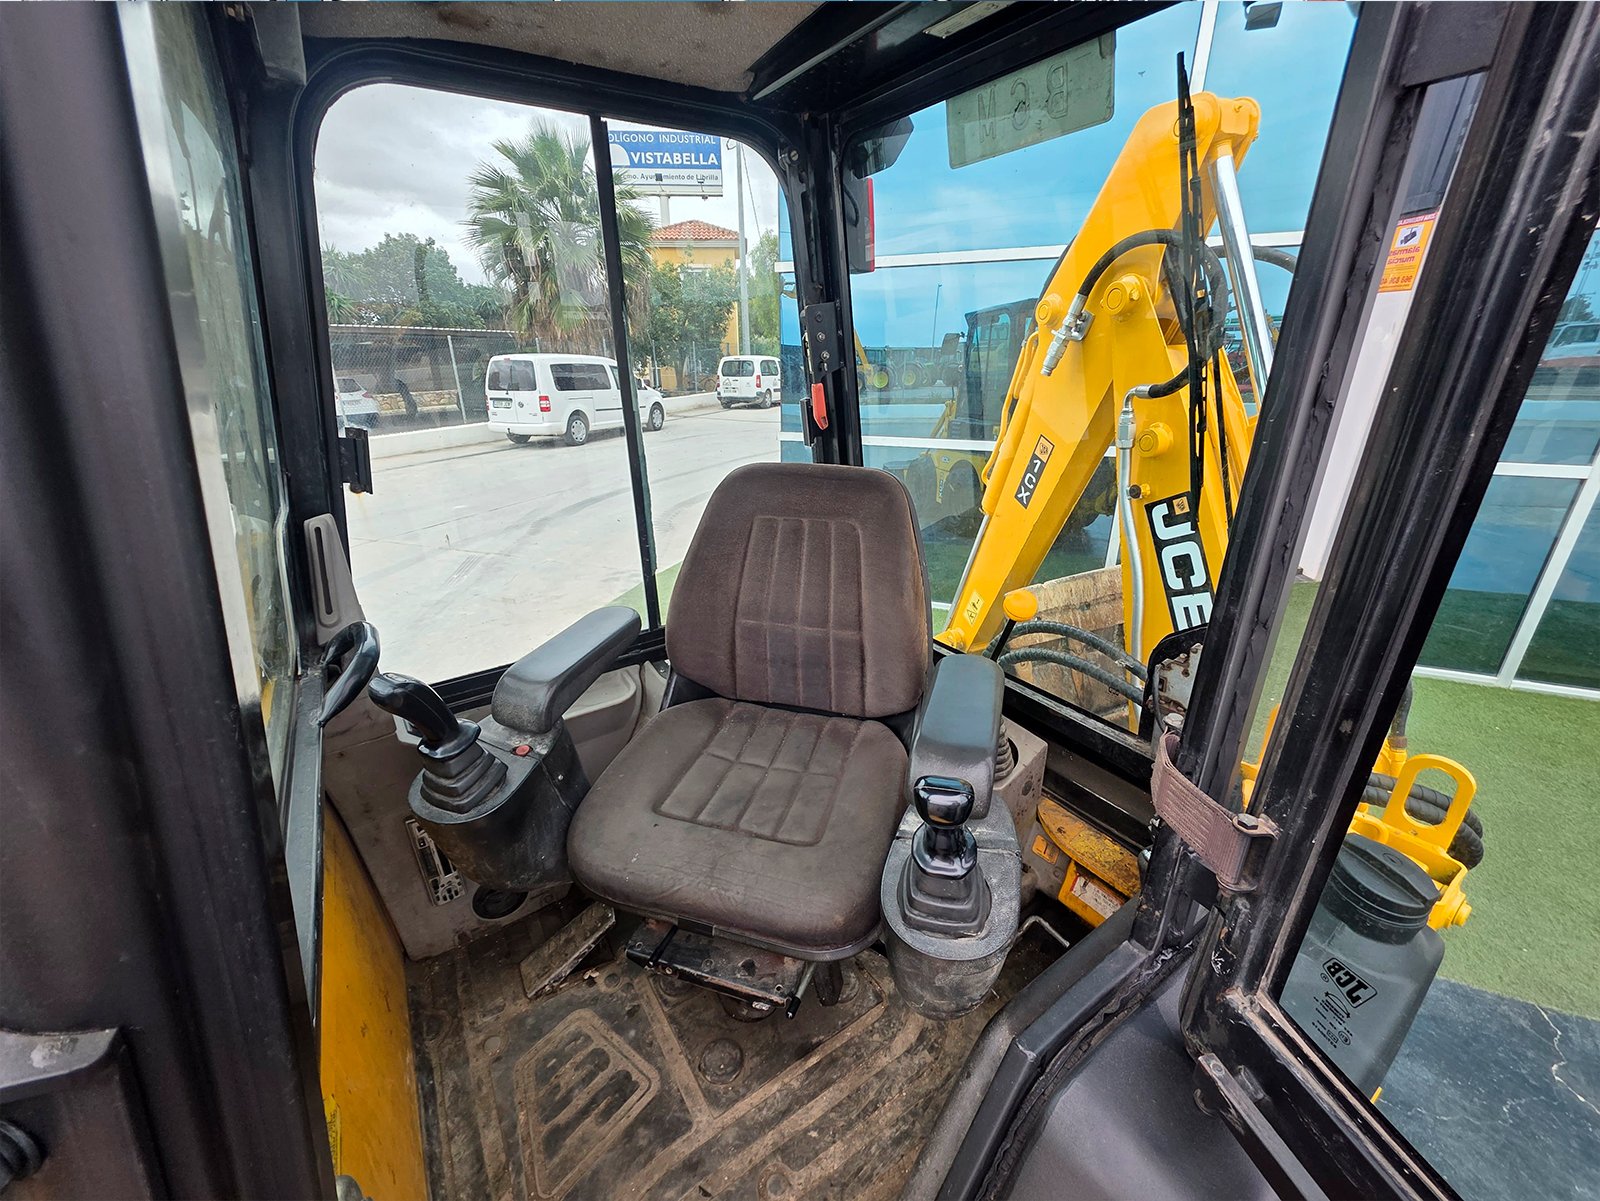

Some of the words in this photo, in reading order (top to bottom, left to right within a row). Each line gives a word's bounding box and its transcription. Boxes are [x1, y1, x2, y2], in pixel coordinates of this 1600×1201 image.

[608, 132, 654, 143] OLÍGONO
[659, 134, 716, 144] INDUSTRIAL
[630, 151, 718, 165] VISTABELLA
[640, 173, 685, 181] Ayunmiento
[1016, 458, 1042, 505] 1CX
[1326, 961, 1369, 1005] JCB
